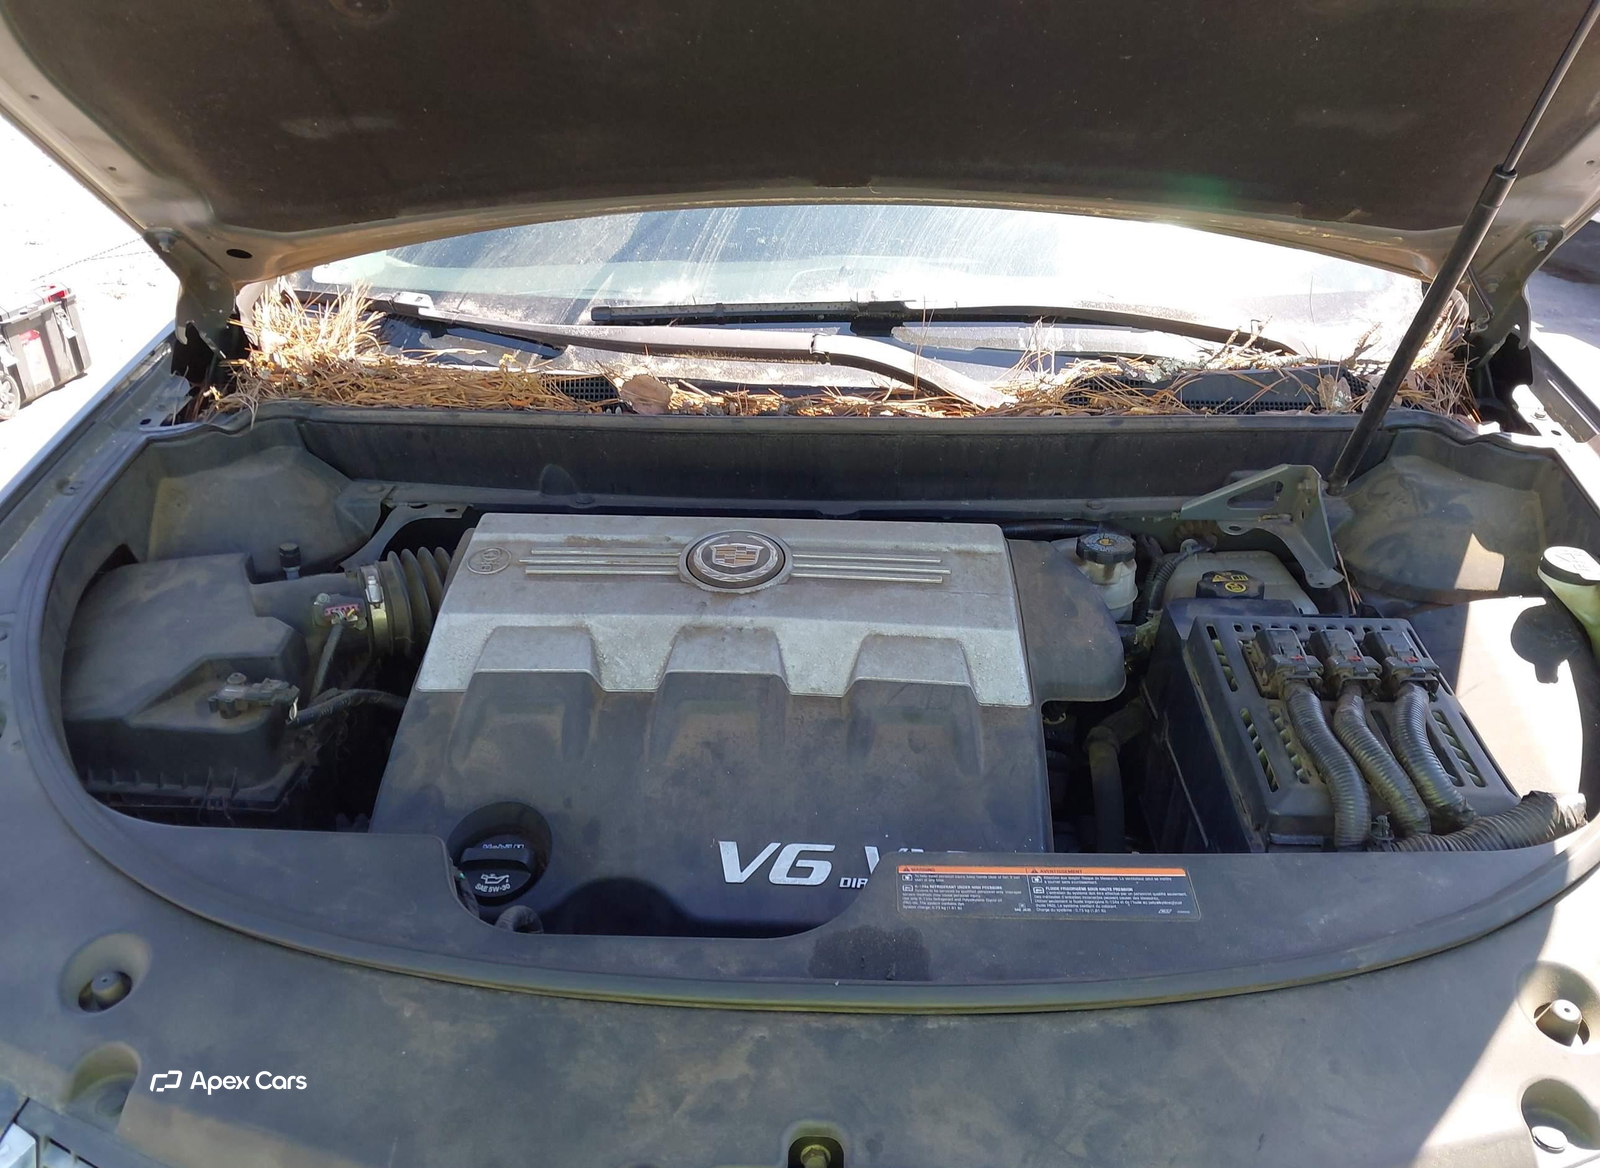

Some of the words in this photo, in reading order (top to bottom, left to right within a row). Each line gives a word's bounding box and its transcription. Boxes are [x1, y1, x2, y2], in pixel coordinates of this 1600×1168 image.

[718, 841, 836, 885] V6
[475, 883, 489, 892] SAE
[488, 884, 511, 892] 5W-30
